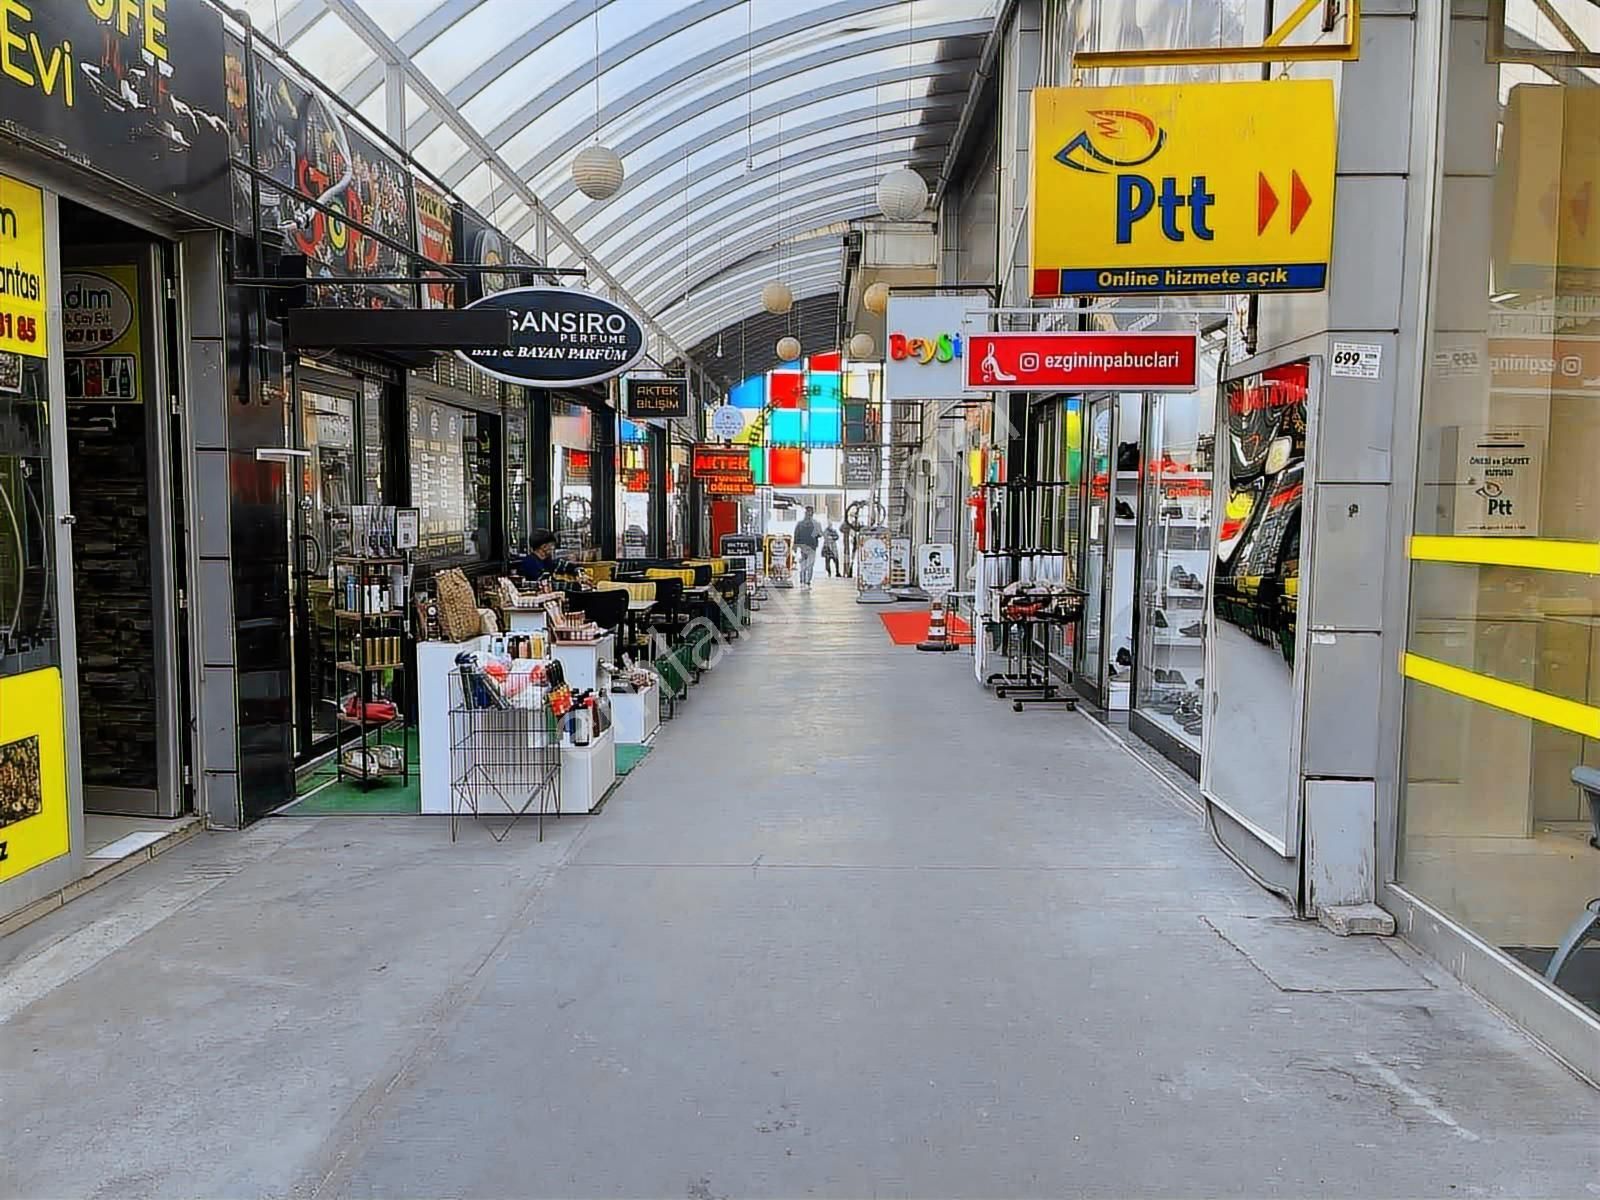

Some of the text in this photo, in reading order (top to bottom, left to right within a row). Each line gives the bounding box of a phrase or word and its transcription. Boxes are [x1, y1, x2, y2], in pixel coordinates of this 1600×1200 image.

[1115, 174, 1215, 244] Ptt
[1098, 267, 1288, 287] Online hizmete açık
[17, 316, 37, 343] 85
[560, 333, 627, 344] PERFUME
[517, 346, 566, 360] BAYAN
[567, 345, 628, 361] PARFÜM
[1044, 350, 1180, 374] ezgininpabuclari
[1334, 351, 1361, 366] 699
[637, 385, 679, 397] AKTEK
[1487, 497, 1513, 516] Ptt
